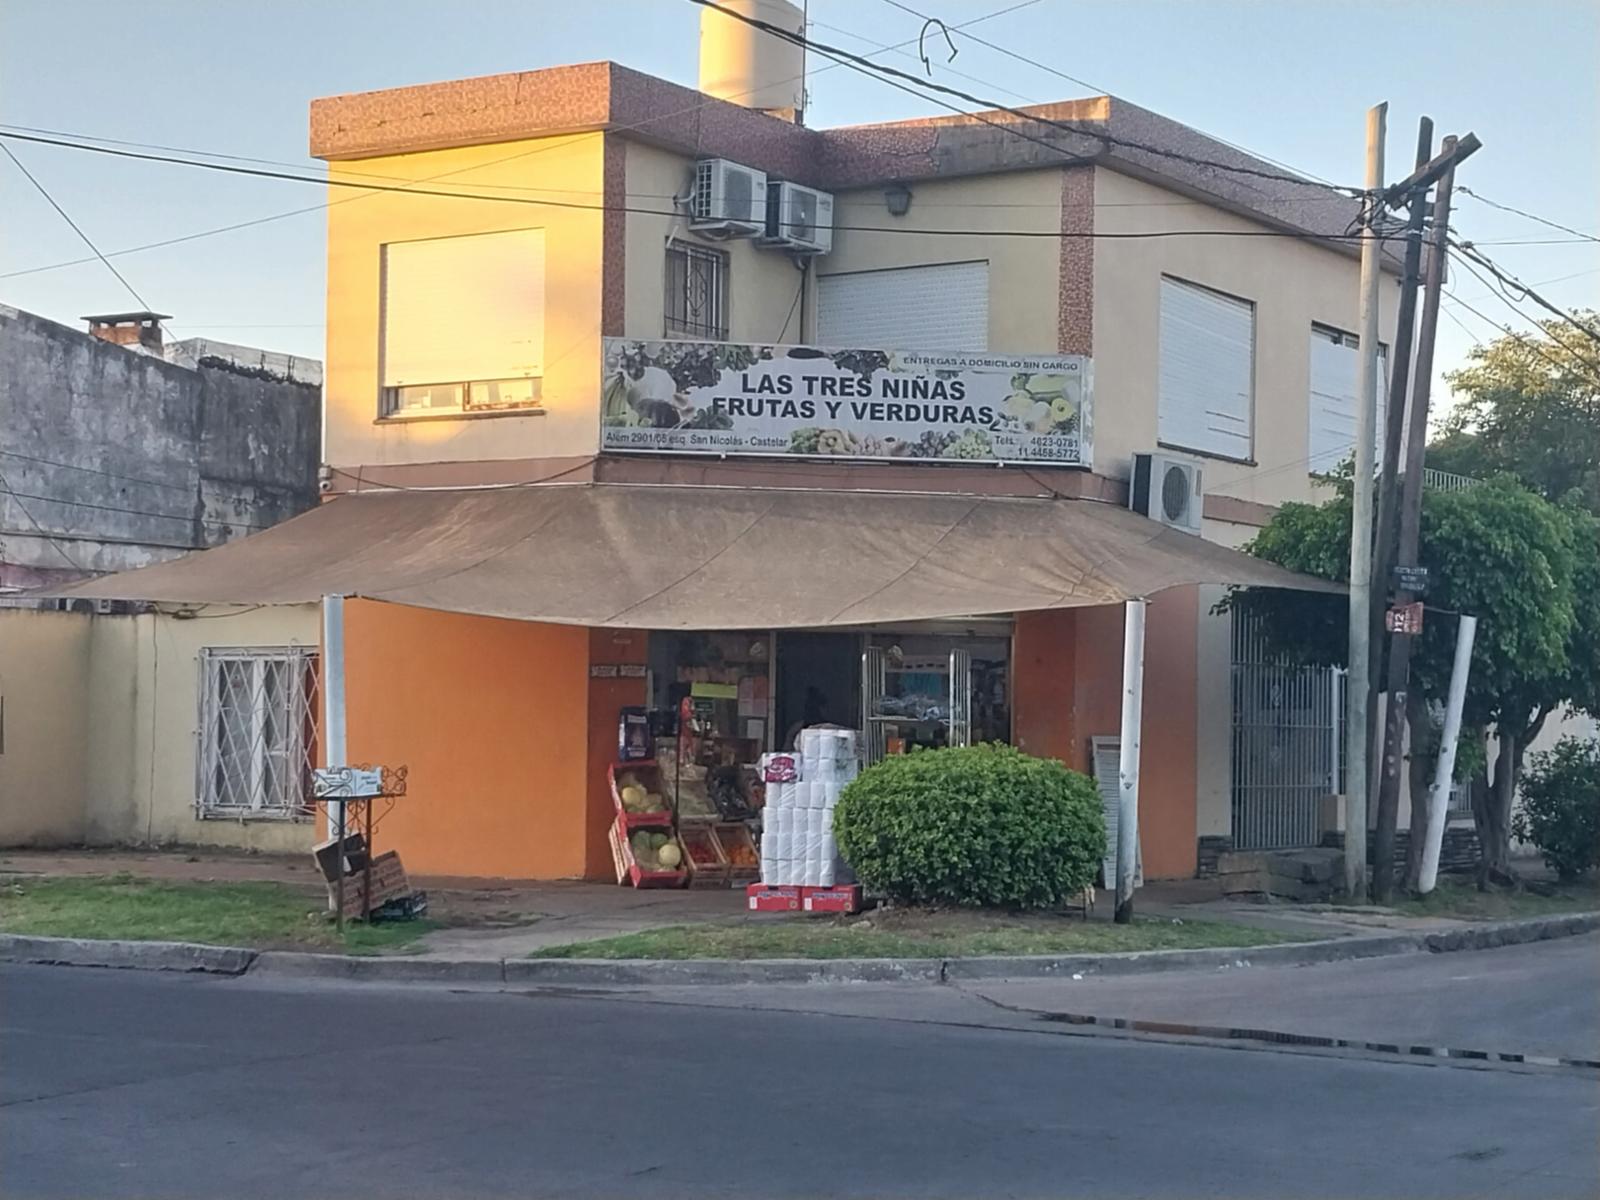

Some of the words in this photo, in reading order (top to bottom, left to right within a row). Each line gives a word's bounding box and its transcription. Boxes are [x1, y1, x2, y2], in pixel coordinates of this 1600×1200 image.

[903, 356, 957, 365] ENTREGAS
[959, 358, 967, 366] A
[968, 359, 1021, 368] DOMICILIO
[1023, 360, 1040, 369] SIN
[1041, 361, 1078, 370] CARGO
[742, 373, 793, 395] LAS
[802, 375, 873, 397] TRES
[882, 375, 966, 400] NIÑAS
[712, 397, 816, 419] FRUTAS
[825, 401, 842, 419] Y
[850, 402, 994, 425] VERDURAS
[690, 433, 708, 444] San
[750, 435, 788, 447] Castelar
